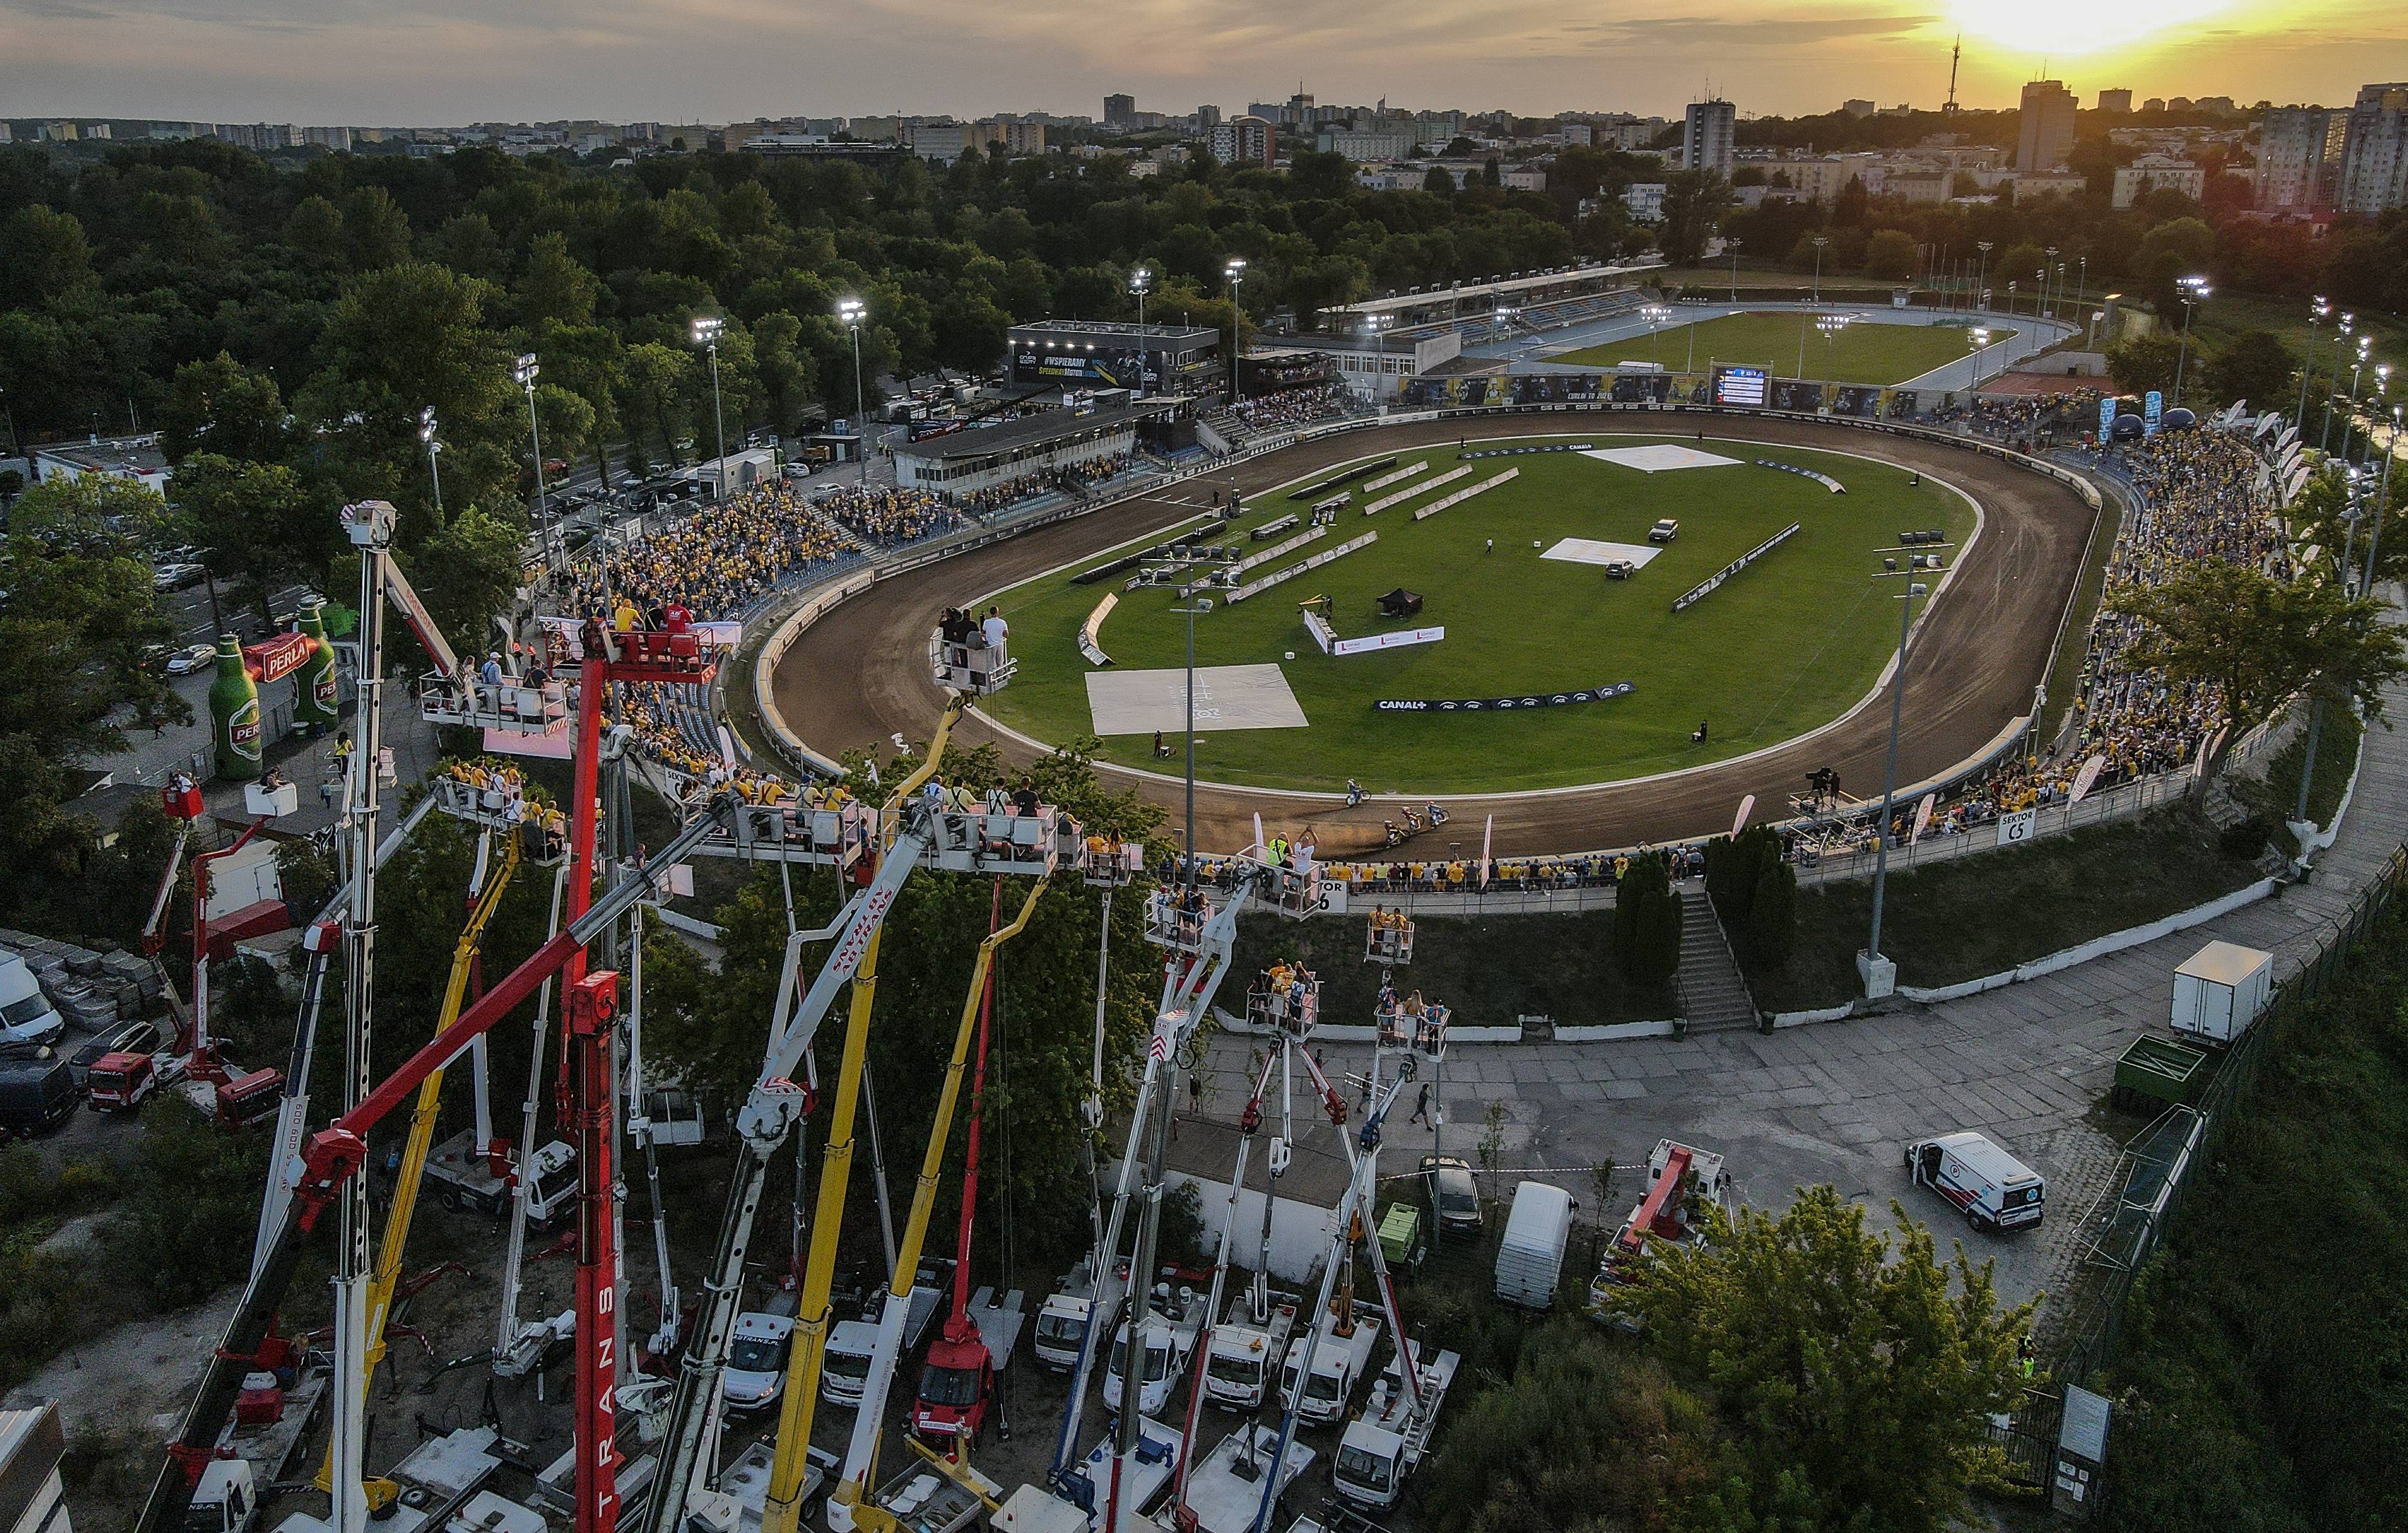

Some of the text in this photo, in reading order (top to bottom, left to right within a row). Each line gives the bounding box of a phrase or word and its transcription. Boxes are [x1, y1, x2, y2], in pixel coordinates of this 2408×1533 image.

[1379, 701, 1427, 710] CANAL+
[2002, 811, 2033, 825] SEKTOR
[2008, 822, 2025, 840] C5
[1319, 882, 1342, 891] TOR
[1319, 892, 1330, 910] 6
[842, 888, 893, 976] AB TRANS
[293, 1104, 303, 1125] 009
[598, 1286, 613, 1519] TRANS
